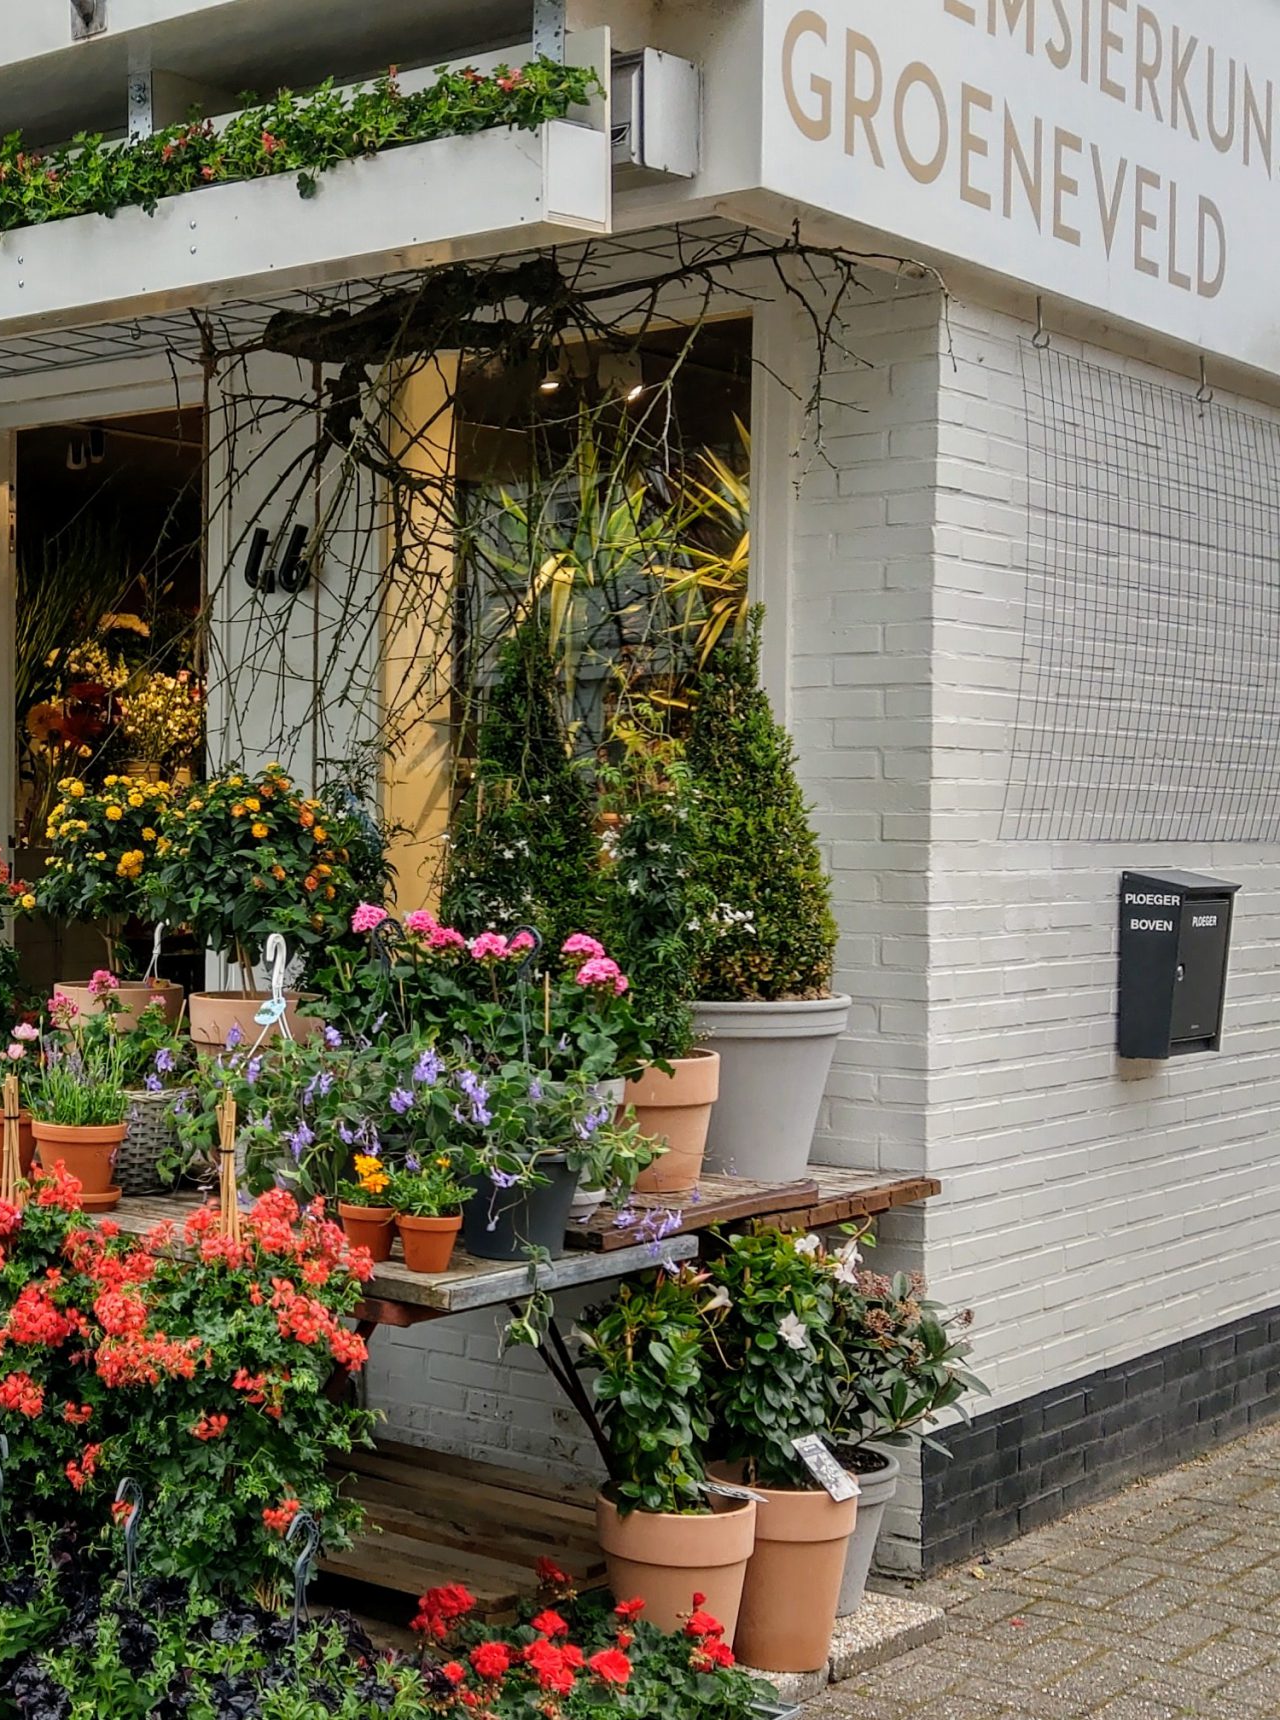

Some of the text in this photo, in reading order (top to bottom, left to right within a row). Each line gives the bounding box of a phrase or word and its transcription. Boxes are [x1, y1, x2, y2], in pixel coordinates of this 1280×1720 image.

[782, 9, 1227, 299] GROENEVELD
[1124, 893, 1180, 906] PLOEGER
[1130, 918, 1173, 932] BOVEN
[1191, 915, 1218, 927] PLOEGER
